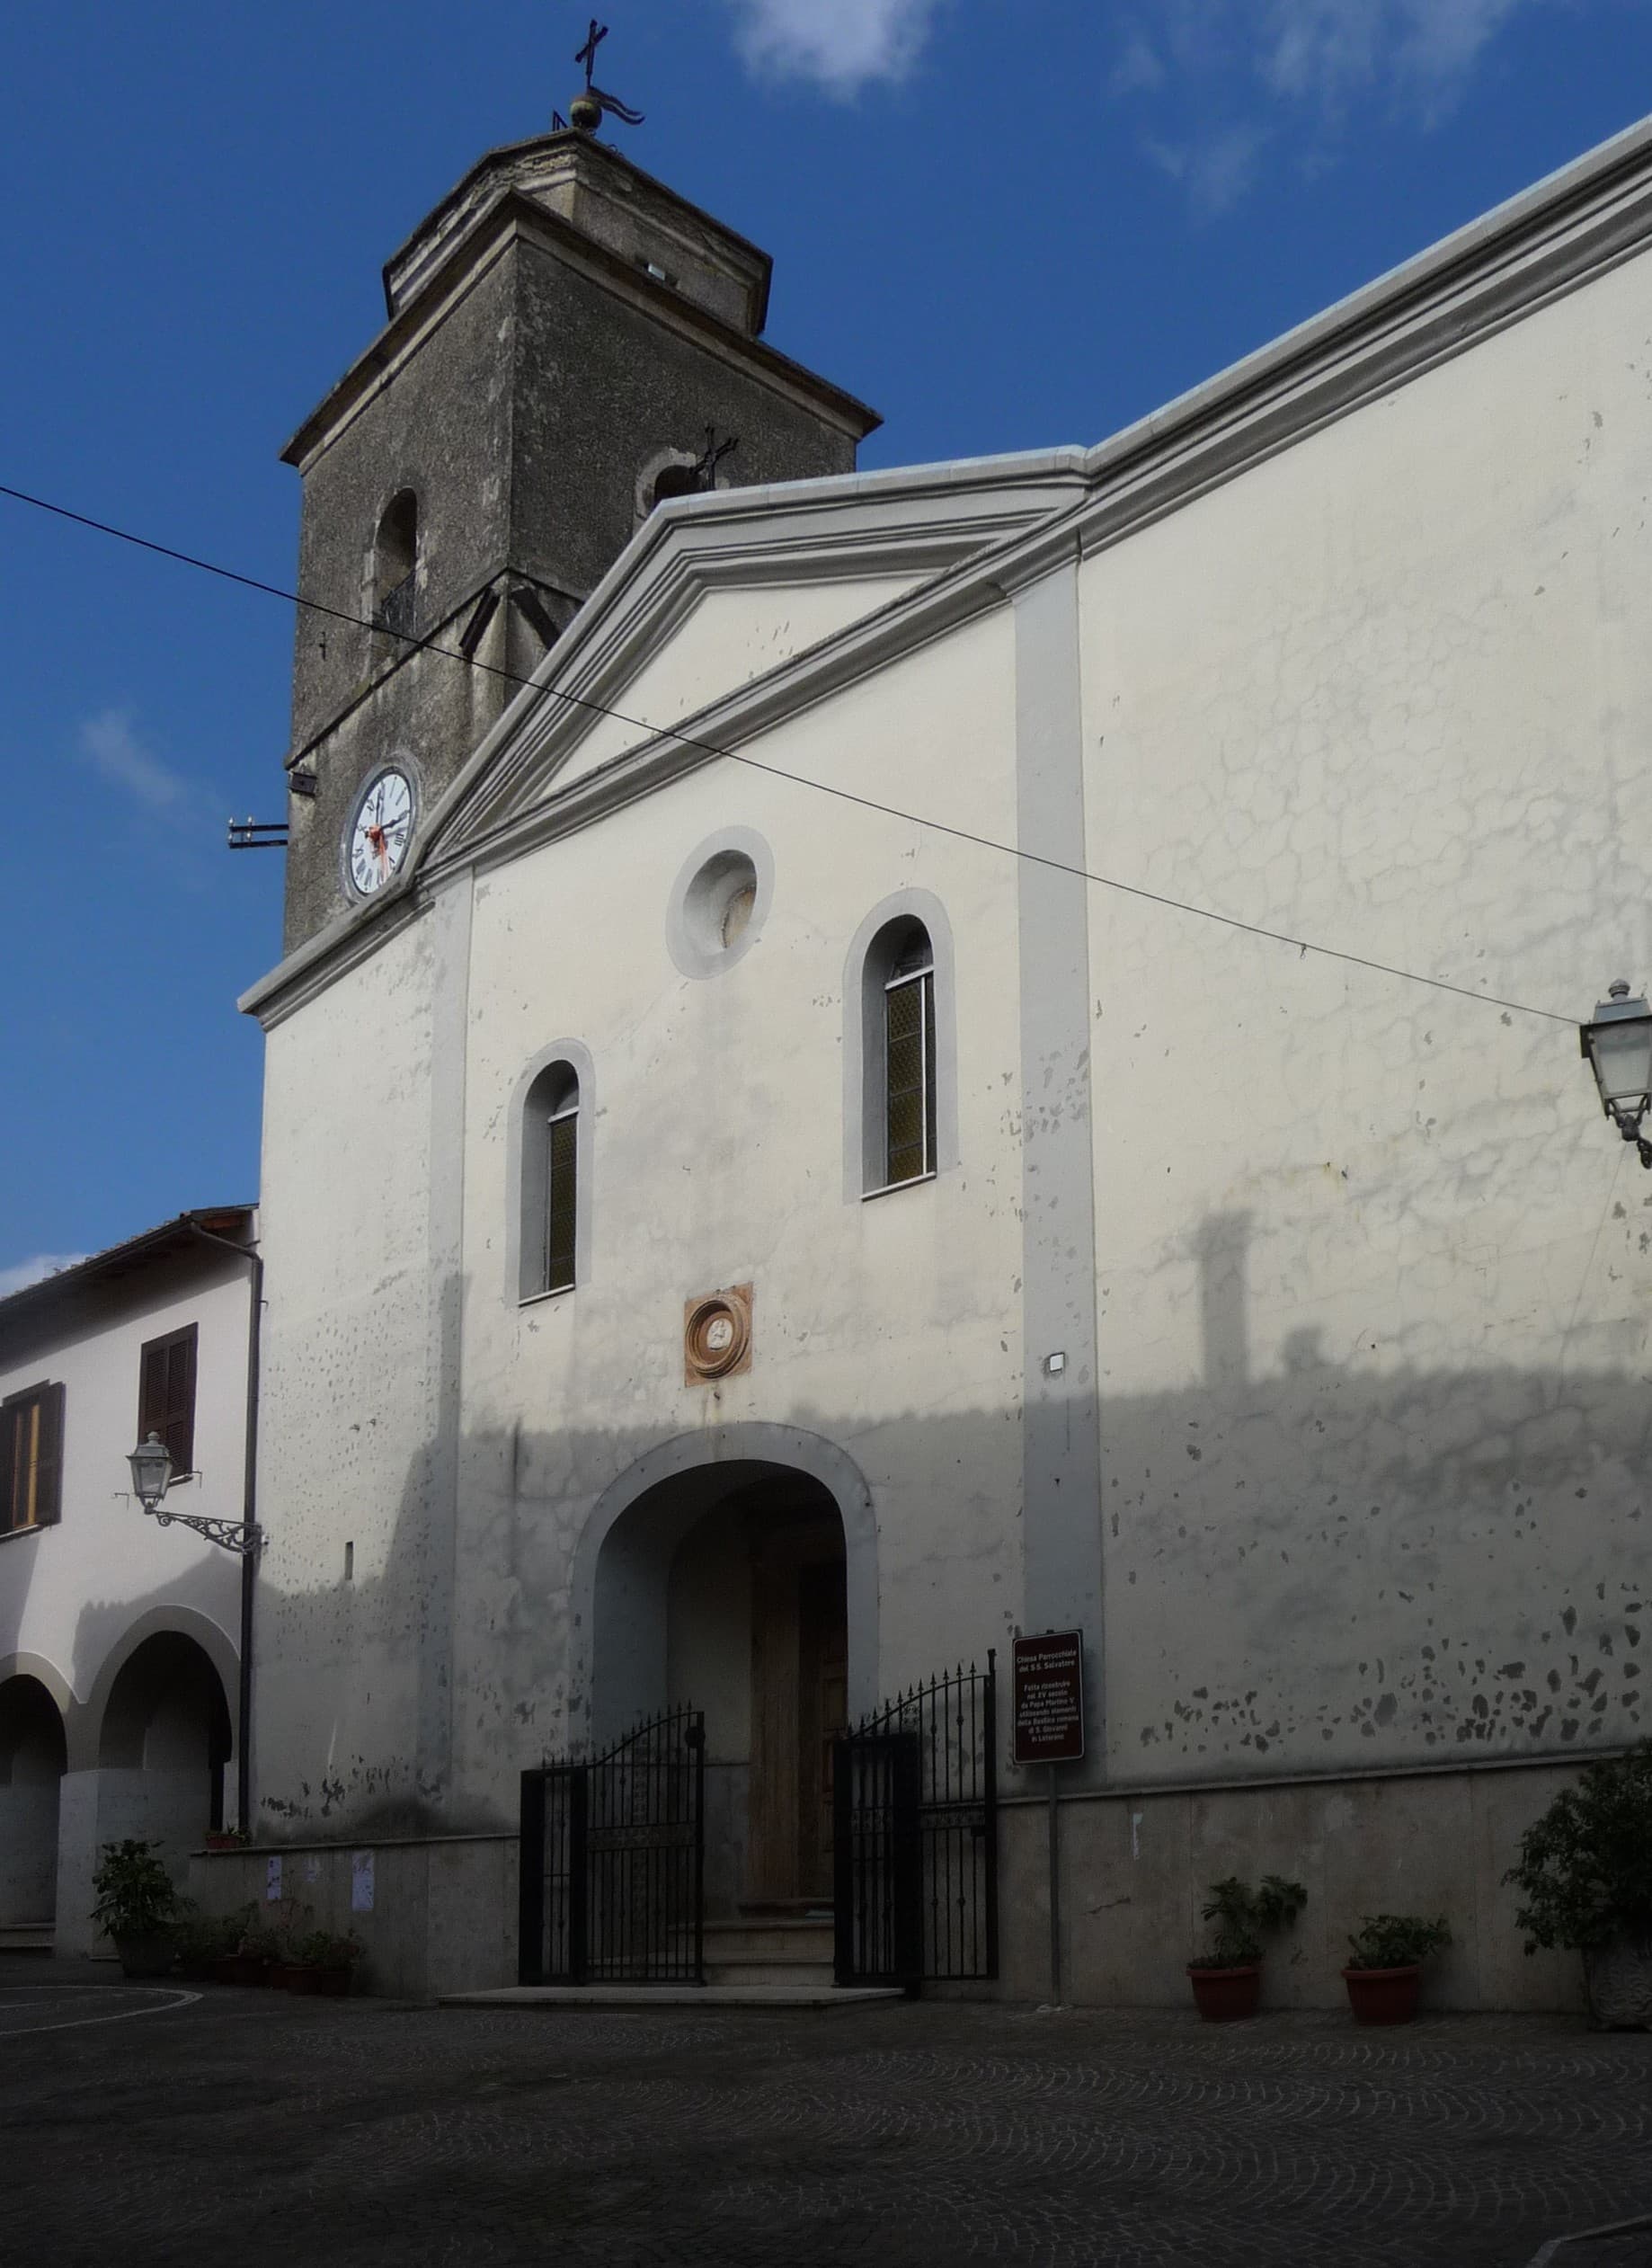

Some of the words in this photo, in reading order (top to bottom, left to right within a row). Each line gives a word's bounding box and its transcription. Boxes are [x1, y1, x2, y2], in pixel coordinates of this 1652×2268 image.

[1017, 1655, 1037, 1664] Chiesa
[1038, 1649, 1077, 1660] Parrocchiale
[1044, 1659, 1075, 1670] Salvatore
[1029, 1701, 1044, 1710] Papa
[1043, 1723, 1068, 1733] Giovanni
